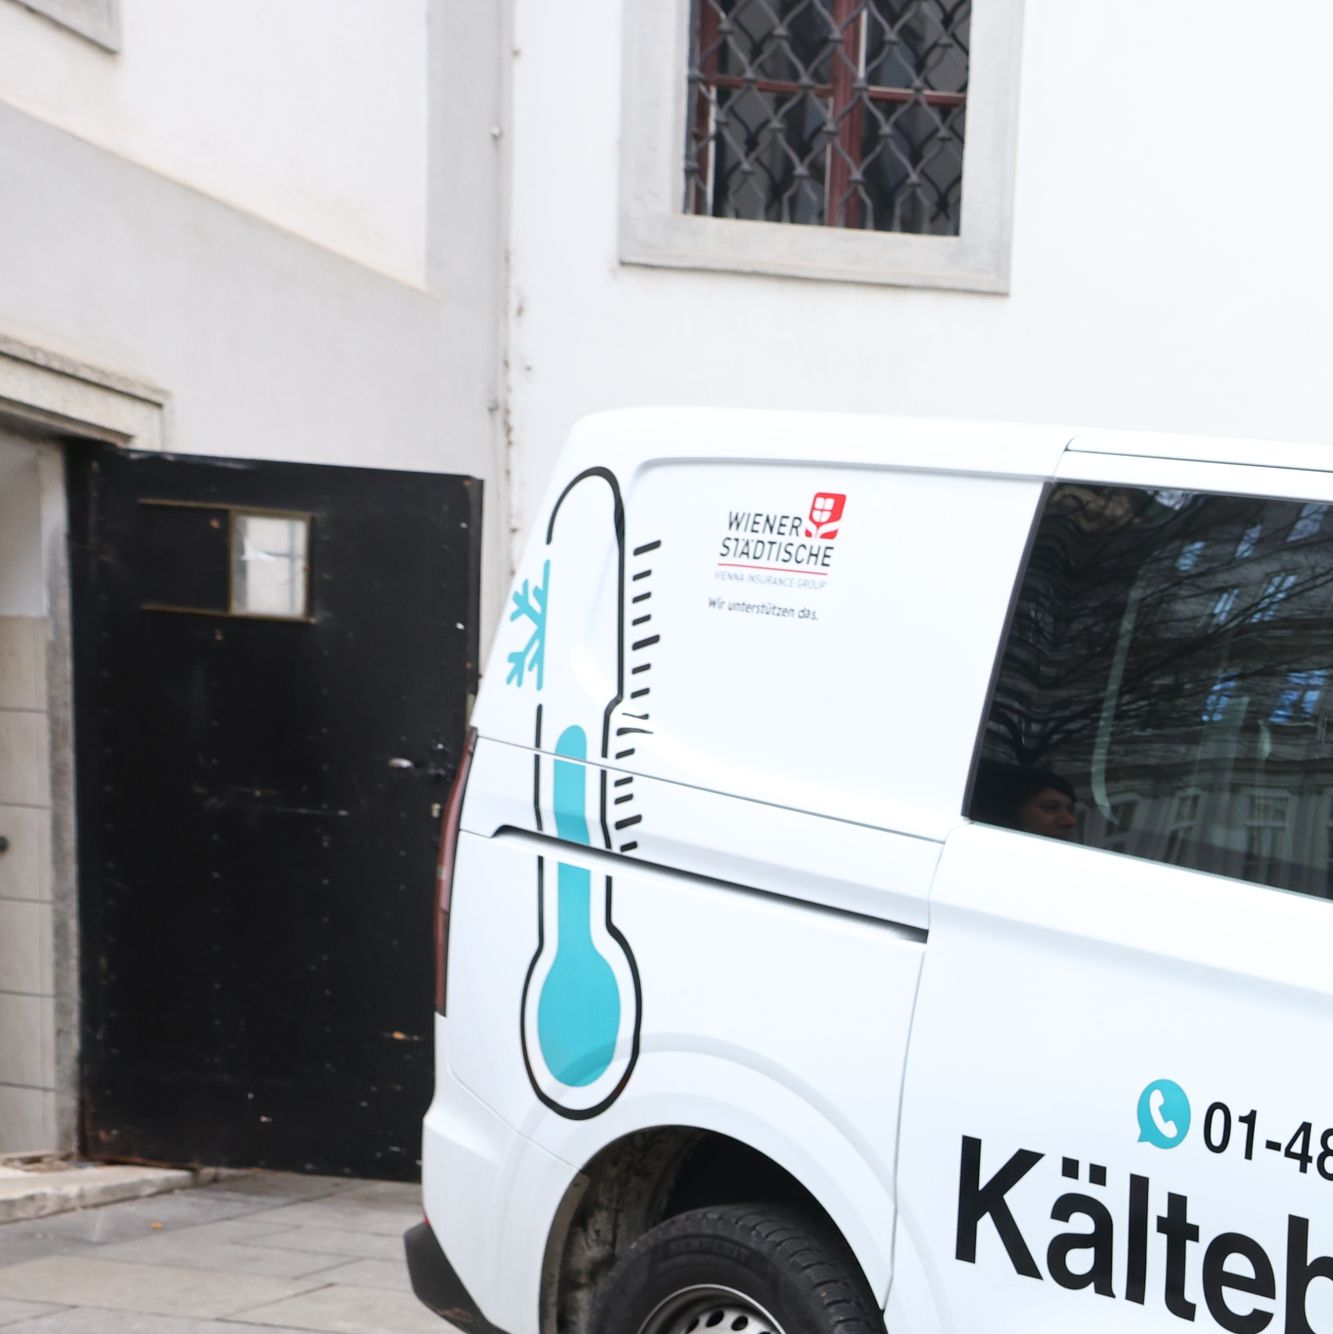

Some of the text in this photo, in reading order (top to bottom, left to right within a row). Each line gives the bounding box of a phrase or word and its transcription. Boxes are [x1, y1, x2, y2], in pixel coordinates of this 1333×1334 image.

[728, 511, 803, 537] WIENER
[720, 537, 834, 567] STÄDTISCHE
[709, 597, 726, 611] Wir
[728, 600, 795, 618] unterstützen
